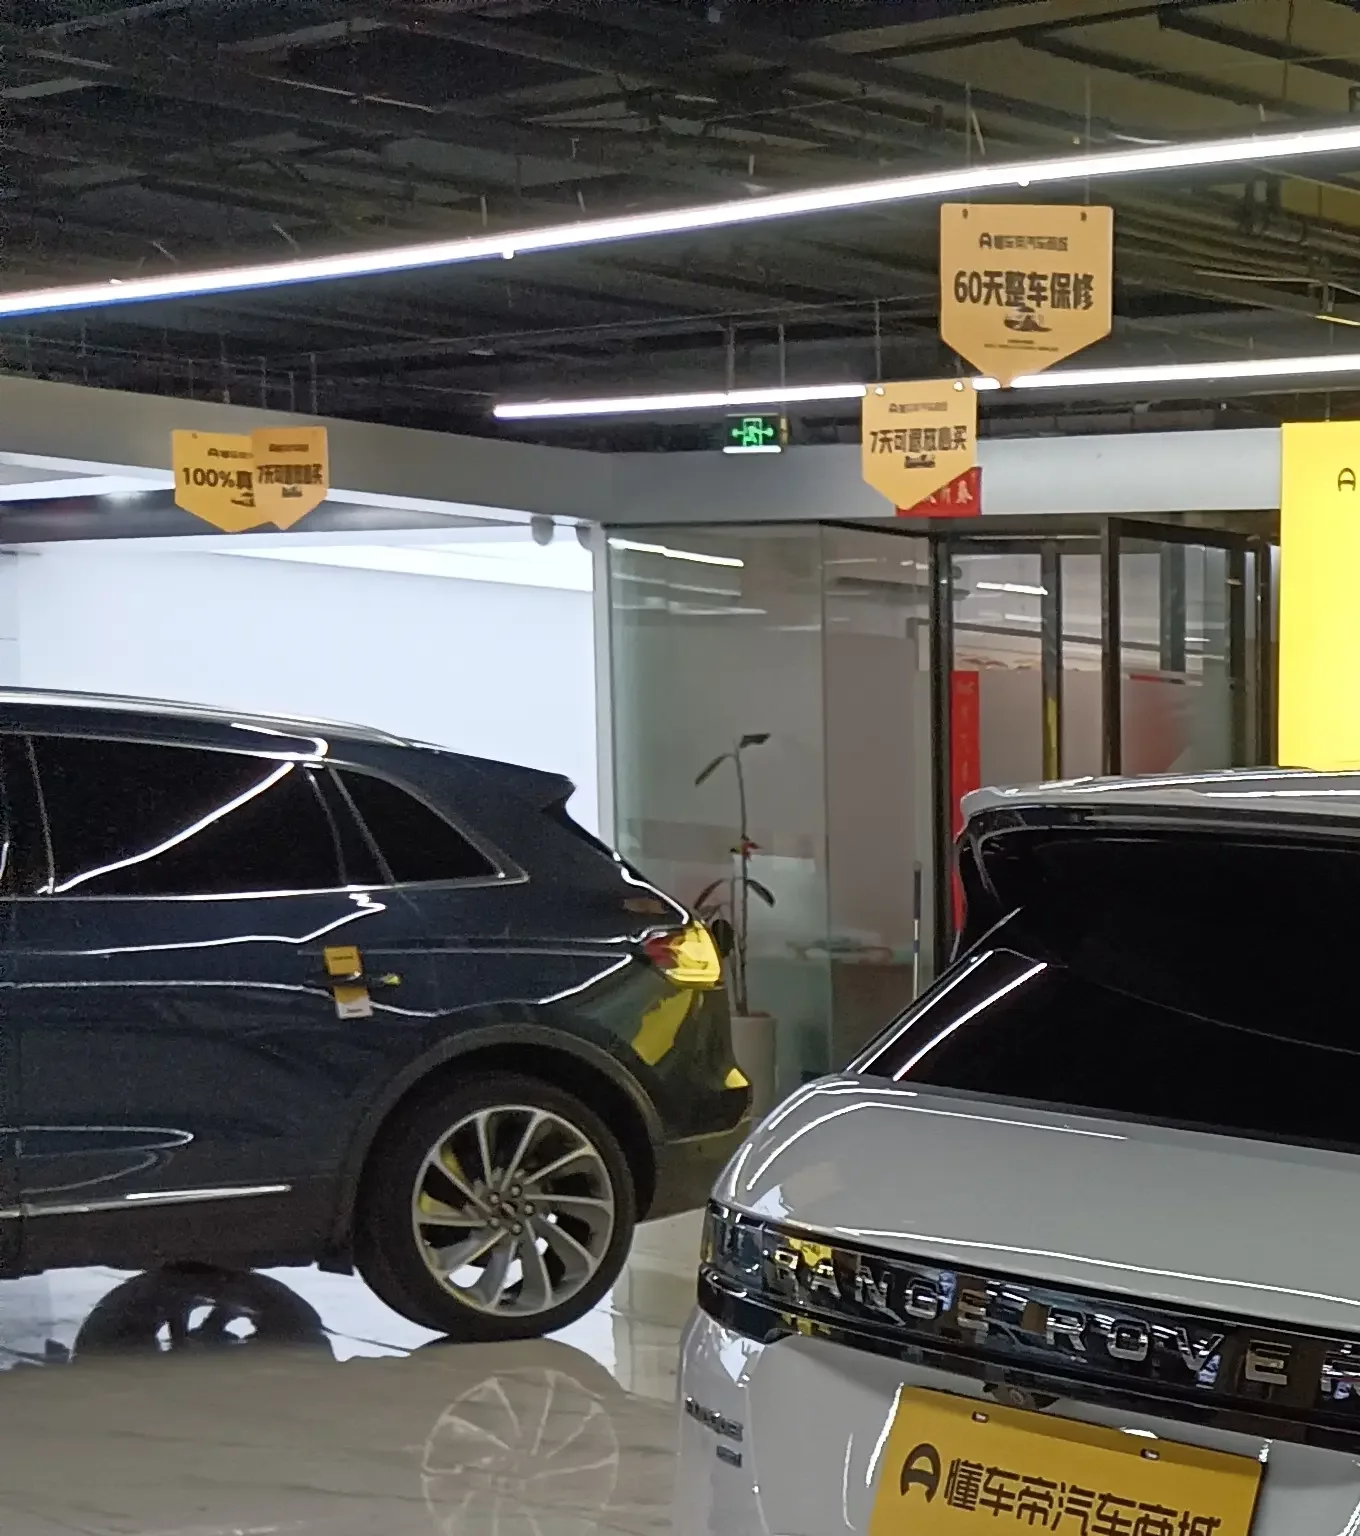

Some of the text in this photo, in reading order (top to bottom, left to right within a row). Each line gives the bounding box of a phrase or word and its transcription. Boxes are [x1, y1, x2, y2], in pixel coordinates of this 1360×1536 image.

[954, 270, 1094, 310] 60天整车保修
[774, 1249, 990, 1332] RANGE
